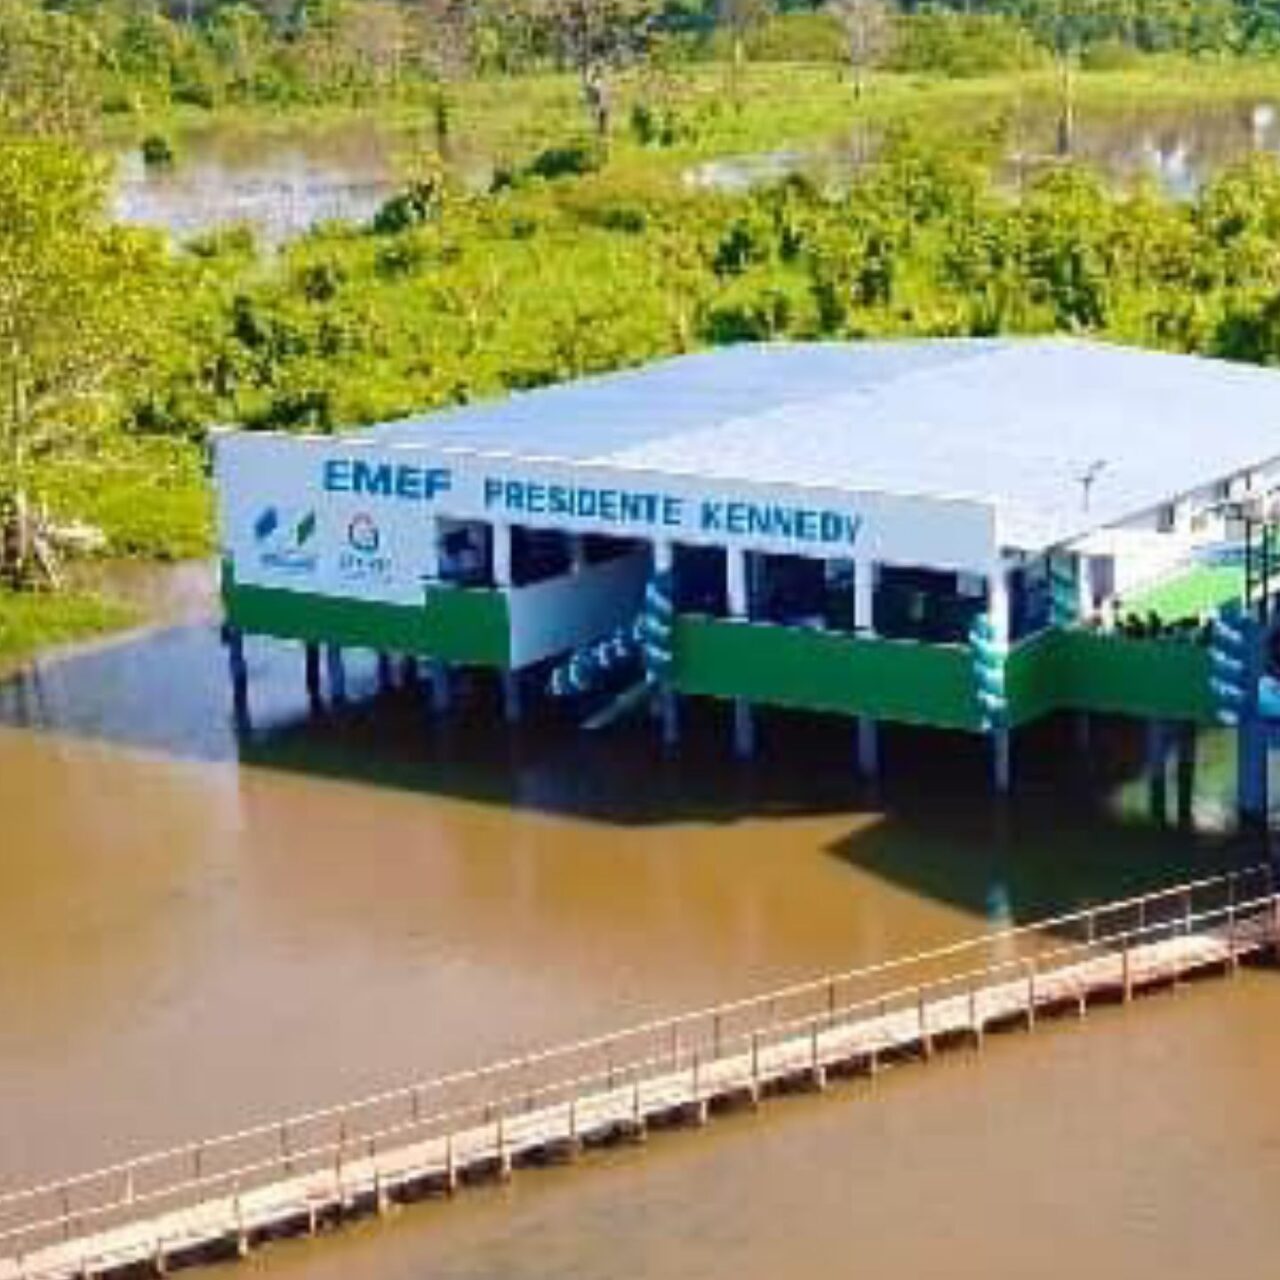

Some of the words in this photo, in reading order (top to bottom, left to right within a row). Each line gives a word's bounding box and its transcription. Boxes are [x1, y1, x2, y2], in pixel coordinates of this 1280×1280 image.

[324, 460, 450, 500] EMEF
[485, 477, 682, 524] PRESIDENTE
[701, 501, 862, 546] KENNEDY
